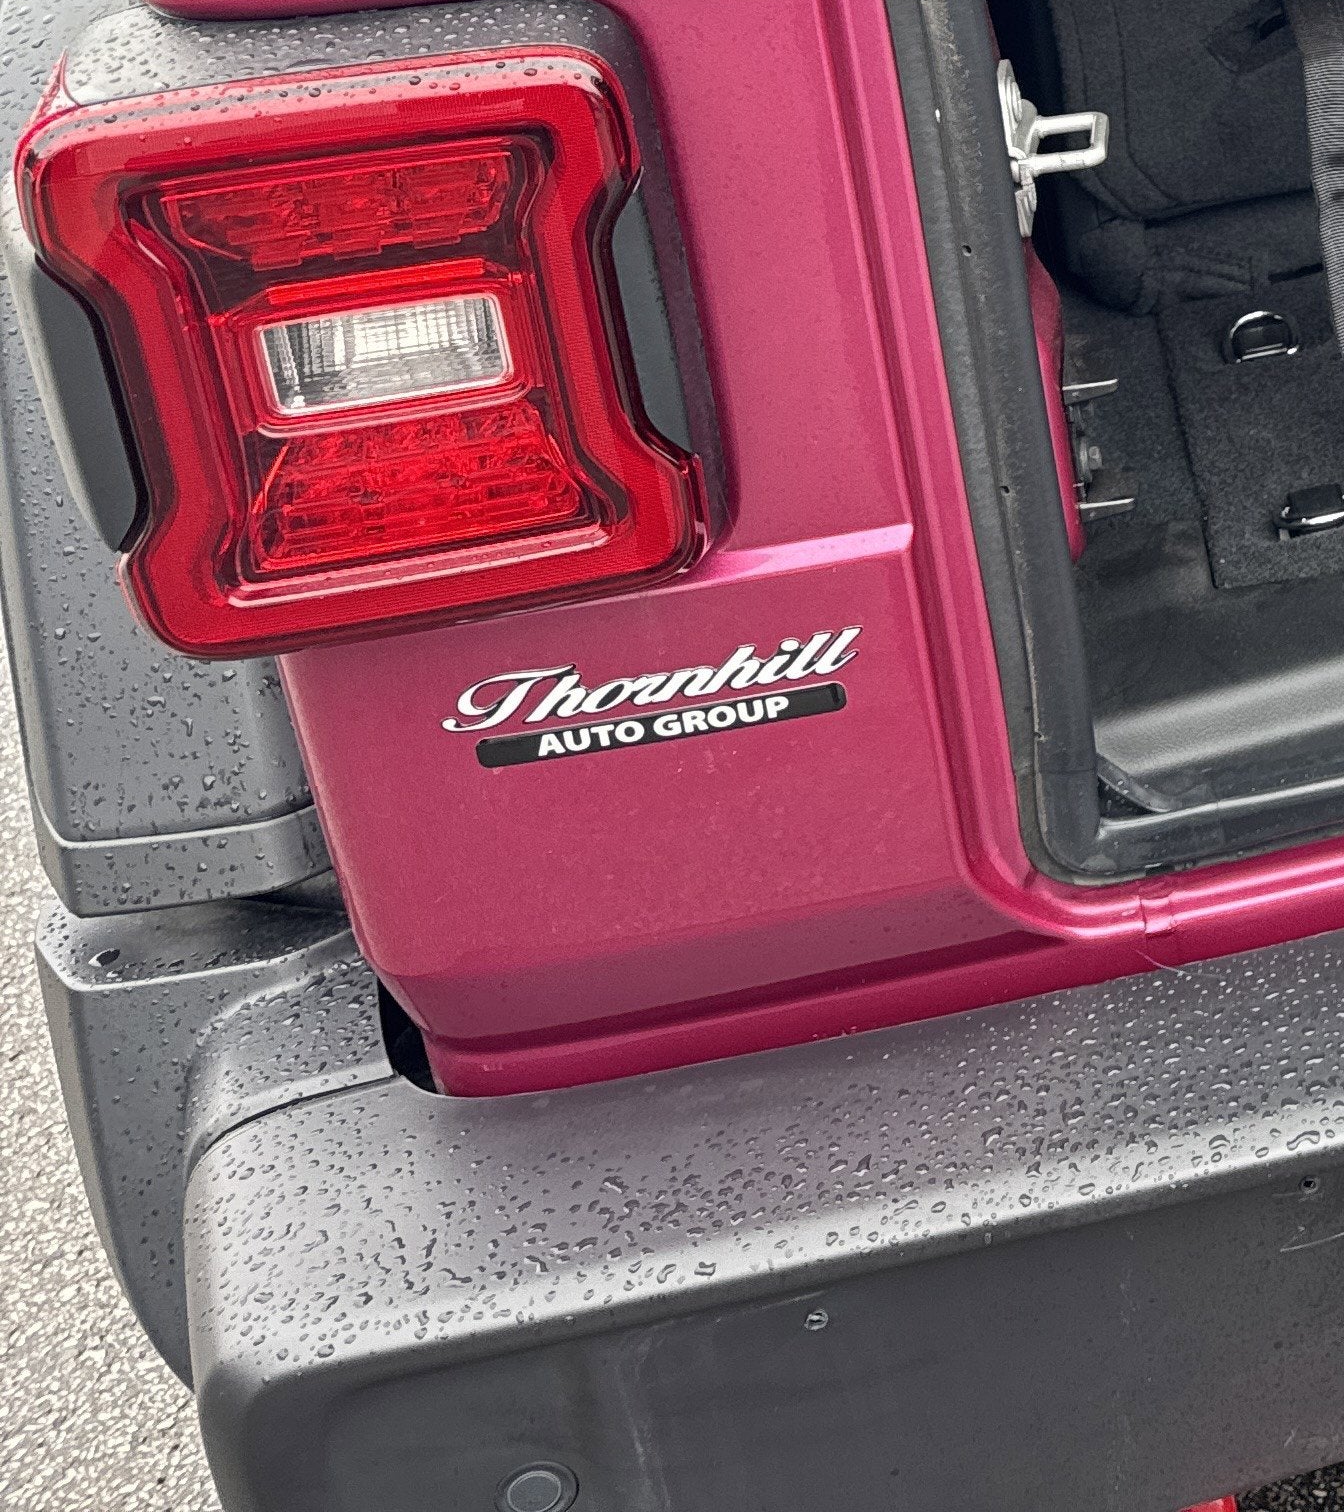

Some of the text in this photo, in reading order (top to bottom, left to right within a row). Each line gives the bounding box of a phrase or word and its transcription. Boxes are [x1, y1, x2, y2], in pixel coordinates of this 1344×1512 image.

[441, 625, 864, 733] Thornhill
[537, 695, 790, 757] AUTO GROUP
